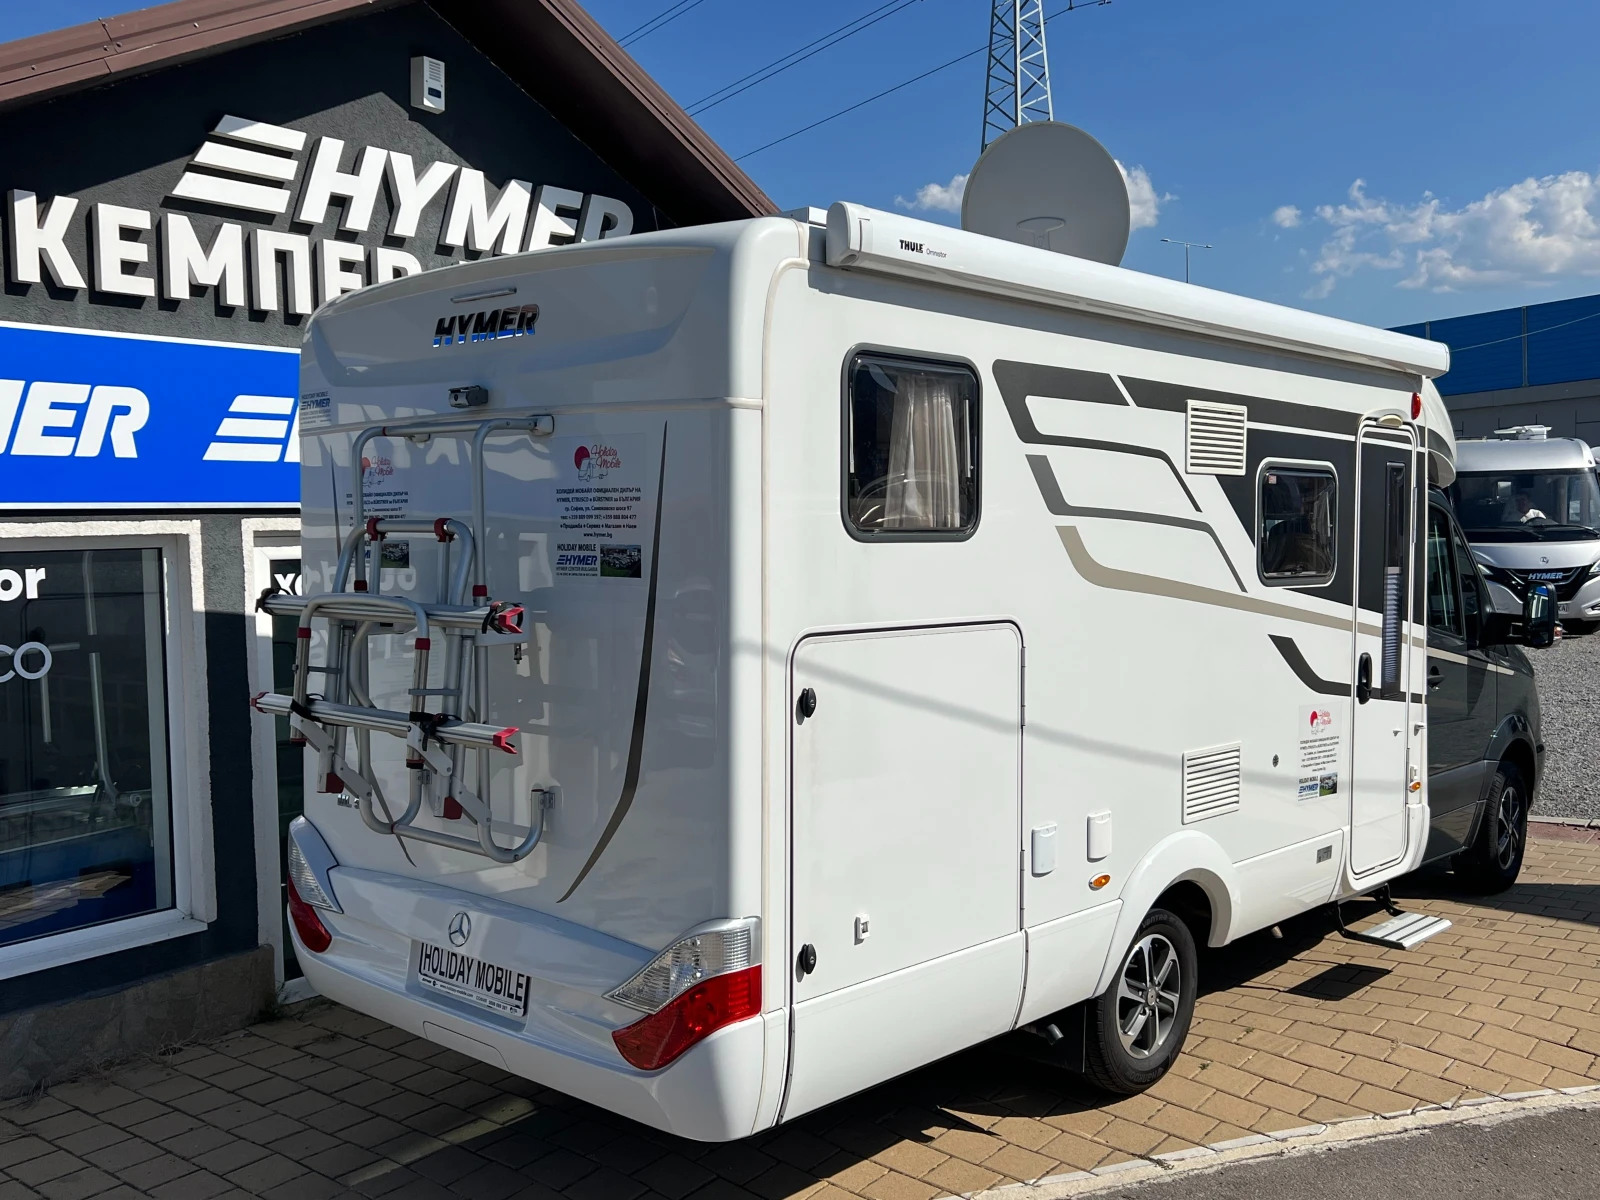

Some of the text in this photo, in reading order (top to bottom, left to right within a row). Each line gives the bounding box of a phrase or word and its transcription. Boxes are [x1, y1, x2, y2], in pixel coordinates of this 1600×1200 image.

[899, 239, 924, 254] THULE
[432, 303, 540, 348] HYMER
[306, 398, 331, 410] HYMER
[591, 444, 618, 458] Holiday
[596, 455, 621, 469] Mobile
[583, 531, 613, 539] www.hymer.bg
[556, 543, 597, 552] HOLIDAY MOBILE
[565, 554, 598, 566] HYMER
[1528, 572, 1564, 581] HYMER
[423, 943, 525, 1003] HOLIDAY MOBILE
